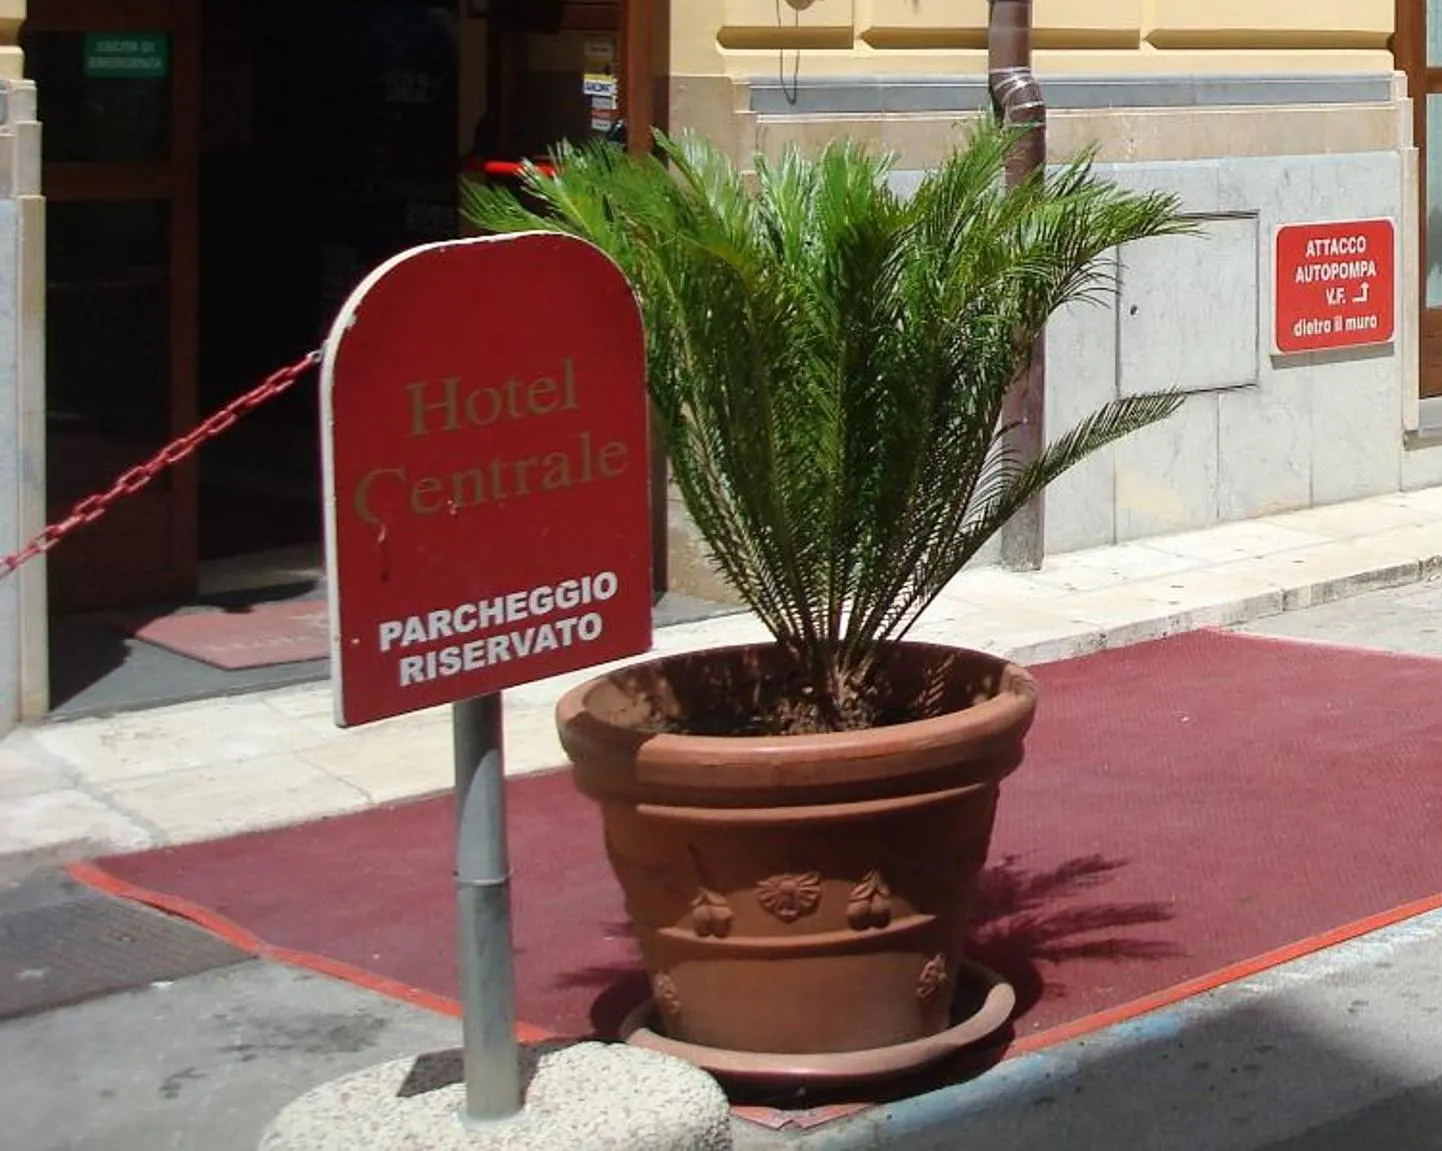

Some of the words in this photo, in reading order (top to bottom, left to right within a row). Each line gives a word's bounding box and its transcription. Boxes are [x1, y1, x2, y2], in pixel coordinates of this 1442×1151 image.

[1295, 260, 1377, 283] AUTOPOMPA
[1305, 235, 1367, 258] ATTACCO
[1293, 318, 1332, 337] dietro
[1333, 315, 1343, 333] il
[1345, 314, 1378, 332] muro
[404, 357, 580, 438] Hotel
[353, 430, 629, 526] Centrale
[379, 571, 618, 651] PARCHEGGIO
[400, 612, 603, 687] RISERVATO
